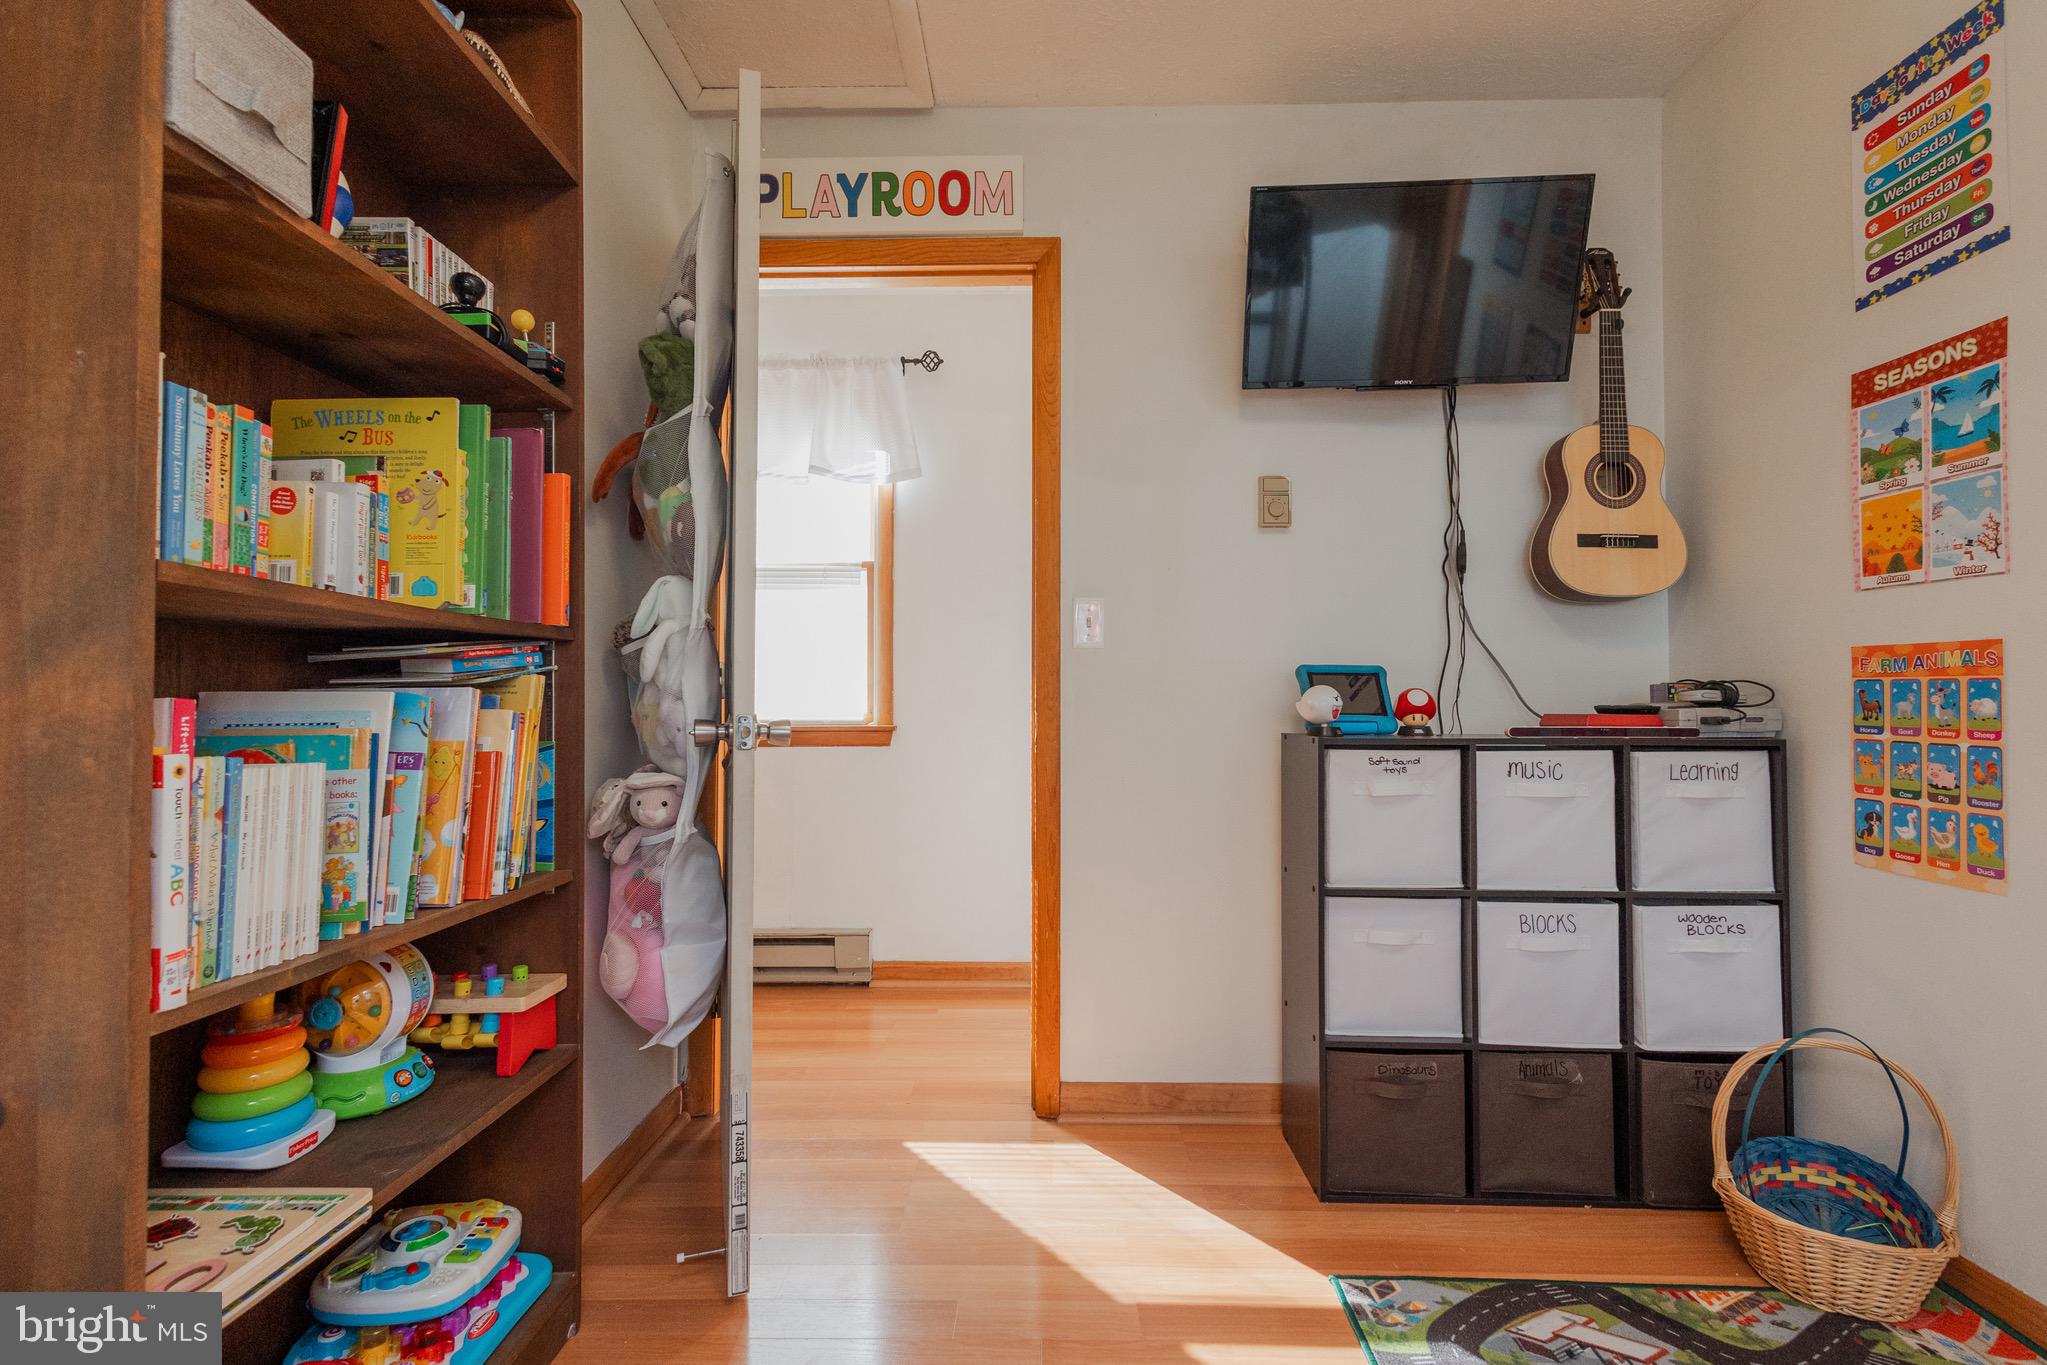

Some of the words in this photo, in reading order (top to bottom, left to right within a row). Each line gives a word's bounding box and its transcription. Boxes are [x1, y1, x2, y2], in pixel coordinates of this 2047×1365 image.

[1915, 46, 1945, 76] the
[1946, 12, 1994, 54] Week
[1897, 82, 1953, 127] Sunday
[1895, 104, 1955, 151] Monday
[1895, 128, 1957, 173] Tuesday
[1883, 149, 1964, 203] Wednesday
[760, 169, 1014, 219] PLAYROOM
[1892, 173, 1961, 221] Thursday
[1903, 204, 1950, 239] Friday
[1893, 223, 1961, 266] Saturday
[1873, 337, 1979, 392] SEASONS
[172, 396, 185, 458] Somebunny
[291, 415, 313, 430] The
[313, 409, 384, 429] WHEELS
[388, 413, 401, 423] on
[404, 411, 422, 424] the
[173, 460, 183, 490] Loves
[1879, 477, 1908, 491] Spring
[1946, 457, 1989, 474] Summer
[173, 494, 183, 513] You
[1876, 573, 1910, 585] Autumn
[1952, 563, 1987, 576] Winter
[1858, 656, 1908, 673] FARM
[1912, 649, 1999, 671] ANIMALS
[180, 716, 190, 754] Lift-th
[1859, 726, 1879, 734] Horse
[1931, 729, 1956, 738] Donkey
[1973, 731, 1996, 740] Sheep
[331, 777, 358, 786] other
[1383, 766, 1408, 775] toys
[1669, 762, 1739, 783] Learning
[174, 787, 184, 820] Touch
[1937, 795, 1950, 804] Pig
[1971, 799, 2000, 809] Rooster
[209, 832, 219, 865] What
[1864, 846, 1877, 855] Dog
[1894, 853, 1916, 862] Goose
[207, 864, 218, 899] Makes
[1976, 867, 1996, 877] Duck
[170, 864, 185, 907] ABC
[1687, 923, 1746, 936] BLOCKS
[1377, 1063, 1437, 1077] Dinosaurs
[1518, 1059, 1569, 1079] Animals
[1695, 1075, 1724, 1089] TOY
